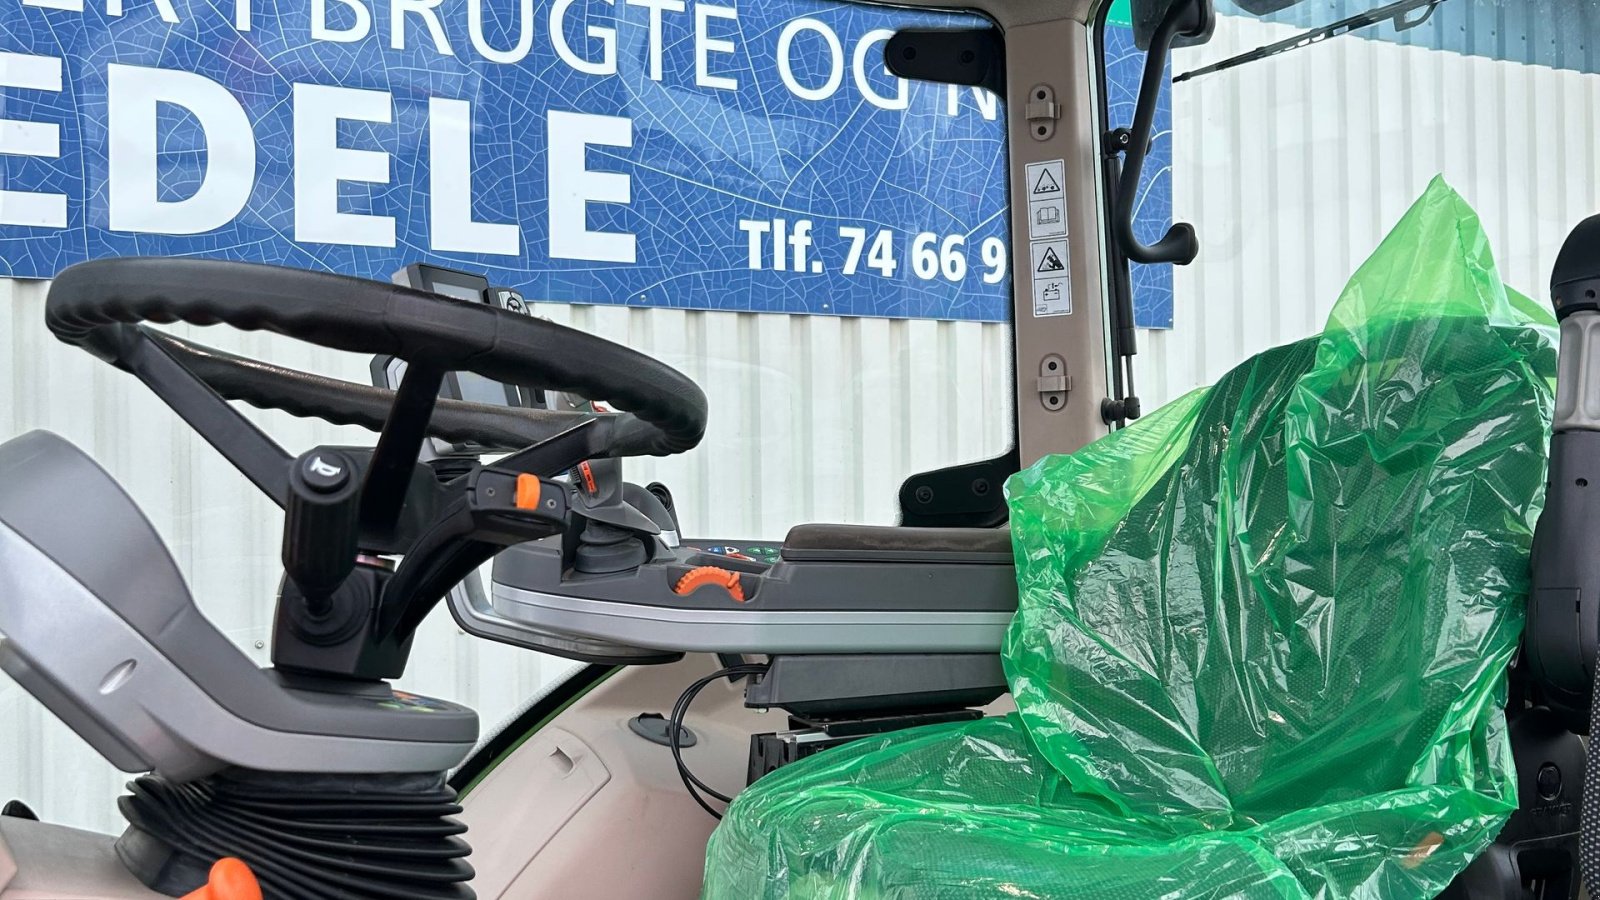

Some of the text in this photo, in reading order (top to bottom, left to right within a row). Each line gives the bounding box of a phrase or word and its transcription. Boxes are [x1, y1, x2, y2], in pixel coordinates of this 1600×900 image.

[776, 18, 908, 110] OG
[739, 218, 823, 273] Tlf.
[839, 226, 896, 277] 74
[911, 231, 967, 282] 66
